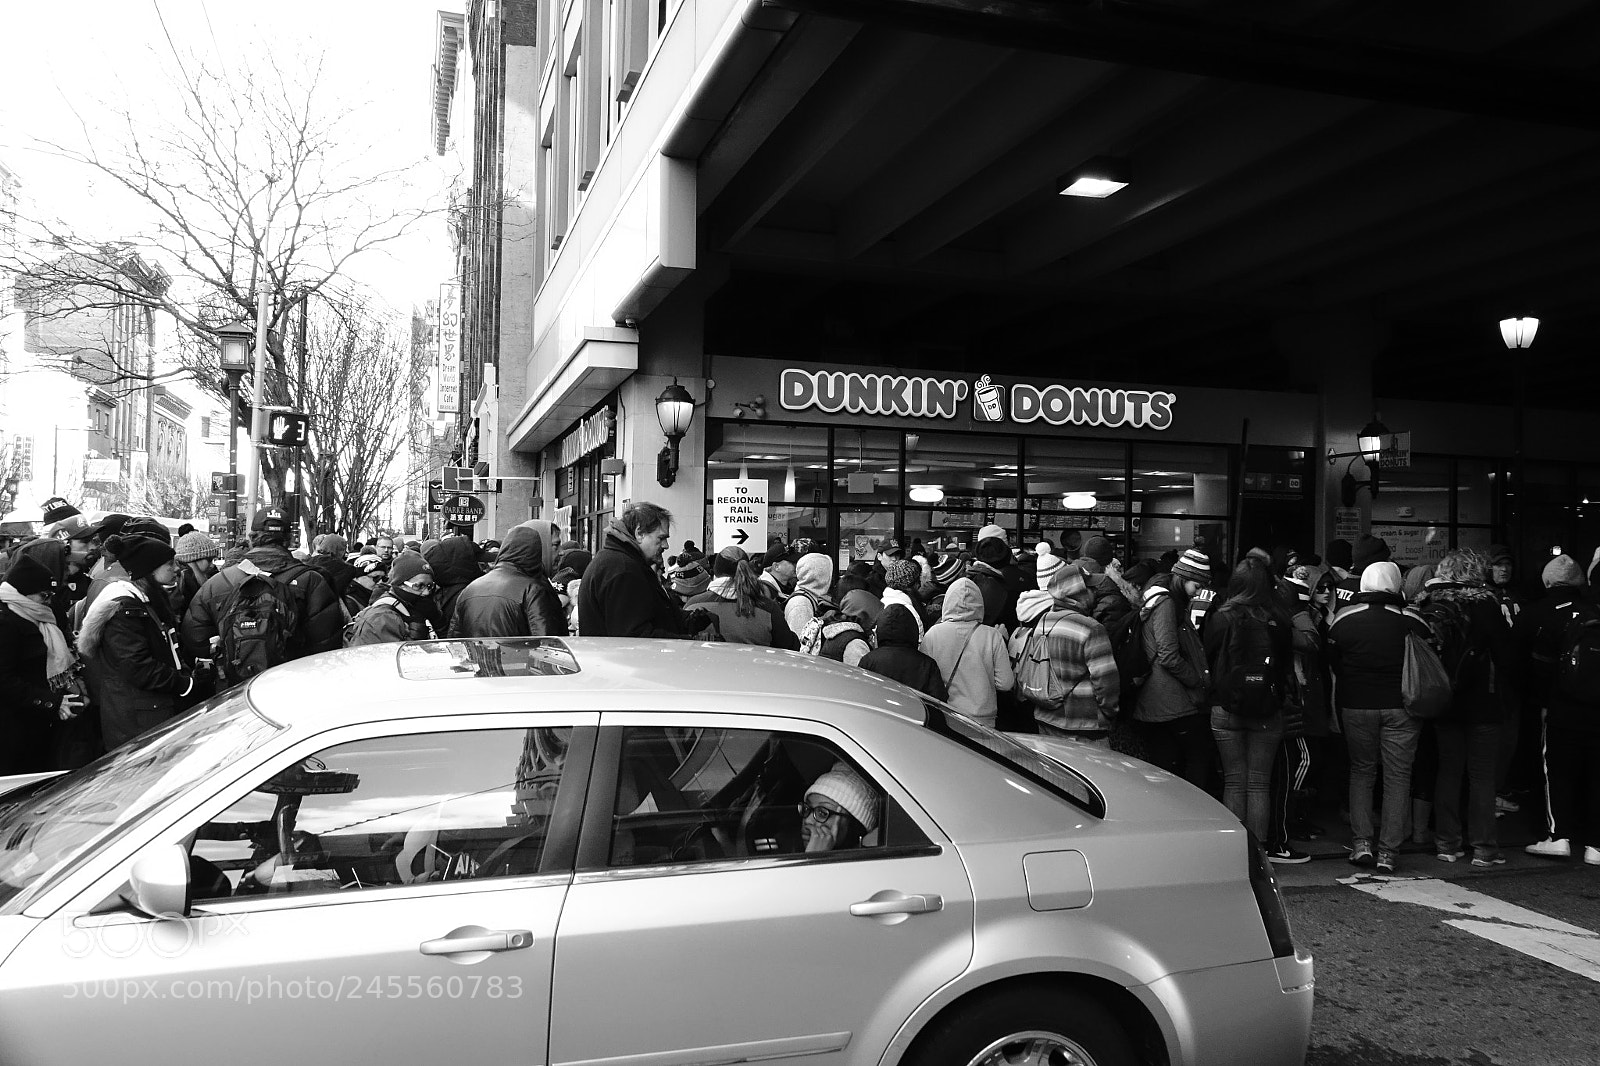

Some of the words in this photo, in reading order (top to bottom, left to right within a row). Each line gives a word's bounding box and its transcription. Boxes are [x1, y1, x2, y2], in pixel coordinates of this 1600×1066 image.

[442, 364, 456, 373] Dream
[443, 374, 456, 383] World
[440, 383, 458, 393] Internet
[443, 393, 454, 403] Cafe
[779, 367, 968, 419] DUNKIN'
[1010, 384, 1174, 430] DONUTS
[296, 420, 306, 441] 3
[717, 496, 766, 504] REGIONAL
[444, 506, 465, 514] PARKE
[466, 507, 483, 515] BANK
[723, 515, 759, 523] TRAINS
[1403, 529, 1420, 537] sugar
